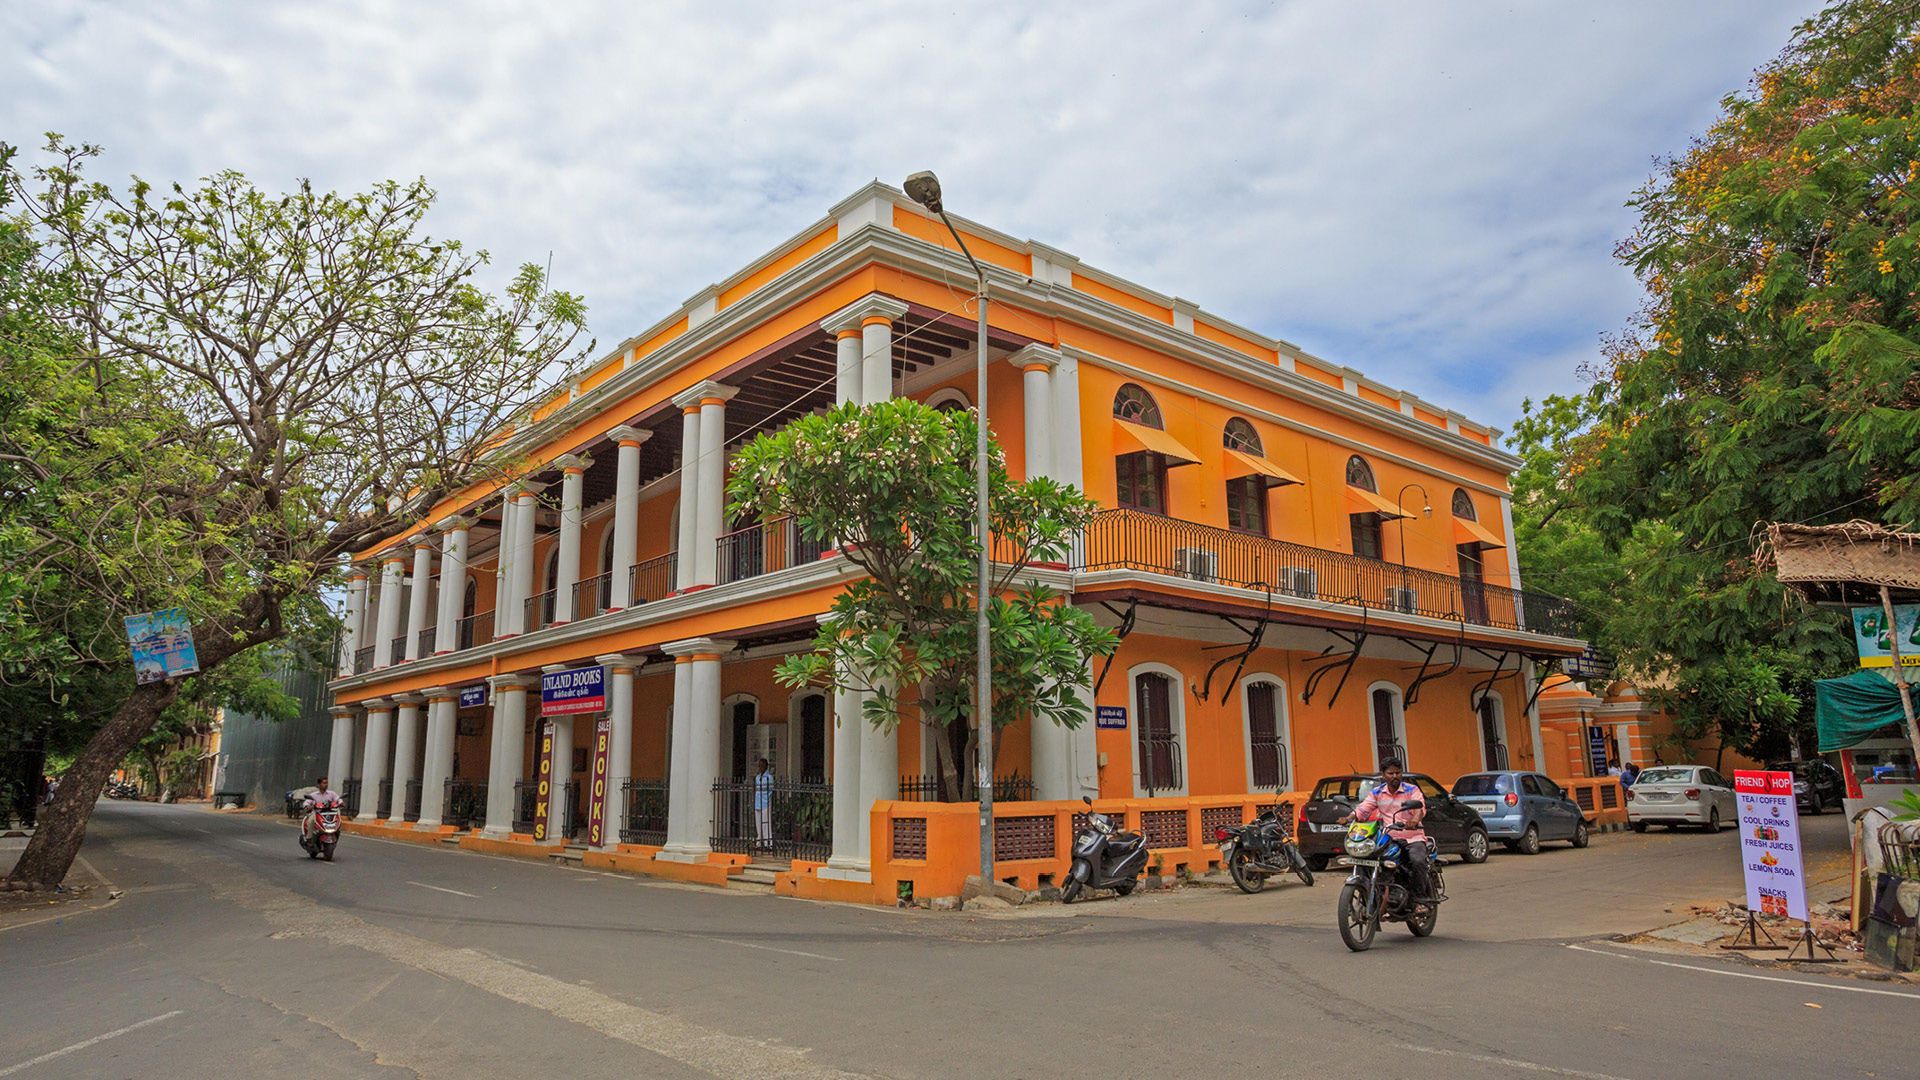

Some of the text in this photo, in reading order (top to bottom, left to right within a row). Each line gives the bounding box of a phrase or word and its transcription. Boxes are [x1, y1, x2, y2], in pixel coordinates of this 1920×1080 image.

[543, 669, 601, 691] INLAND BOOKS
[543, 726, 553, 736] SALE
[598, 720, 610, 732] SALE
[1735, 776, 1764, 787] FRIEND
[535, 738, 551, 839] BOOKS
[592, 735, 606, 843] BOOKS
[1741, 795, 1754, 803] TEA
[1759, 796, 1787, 806] COFFEE
[1743, 816, 1790, 827] COOL DRINKS
[1744, 838, 1794, 852] FRESH JUICES
[1748, 863, 1795, 877] LEMON SODA
[1758, 886, 1787, 898] SNACKS
